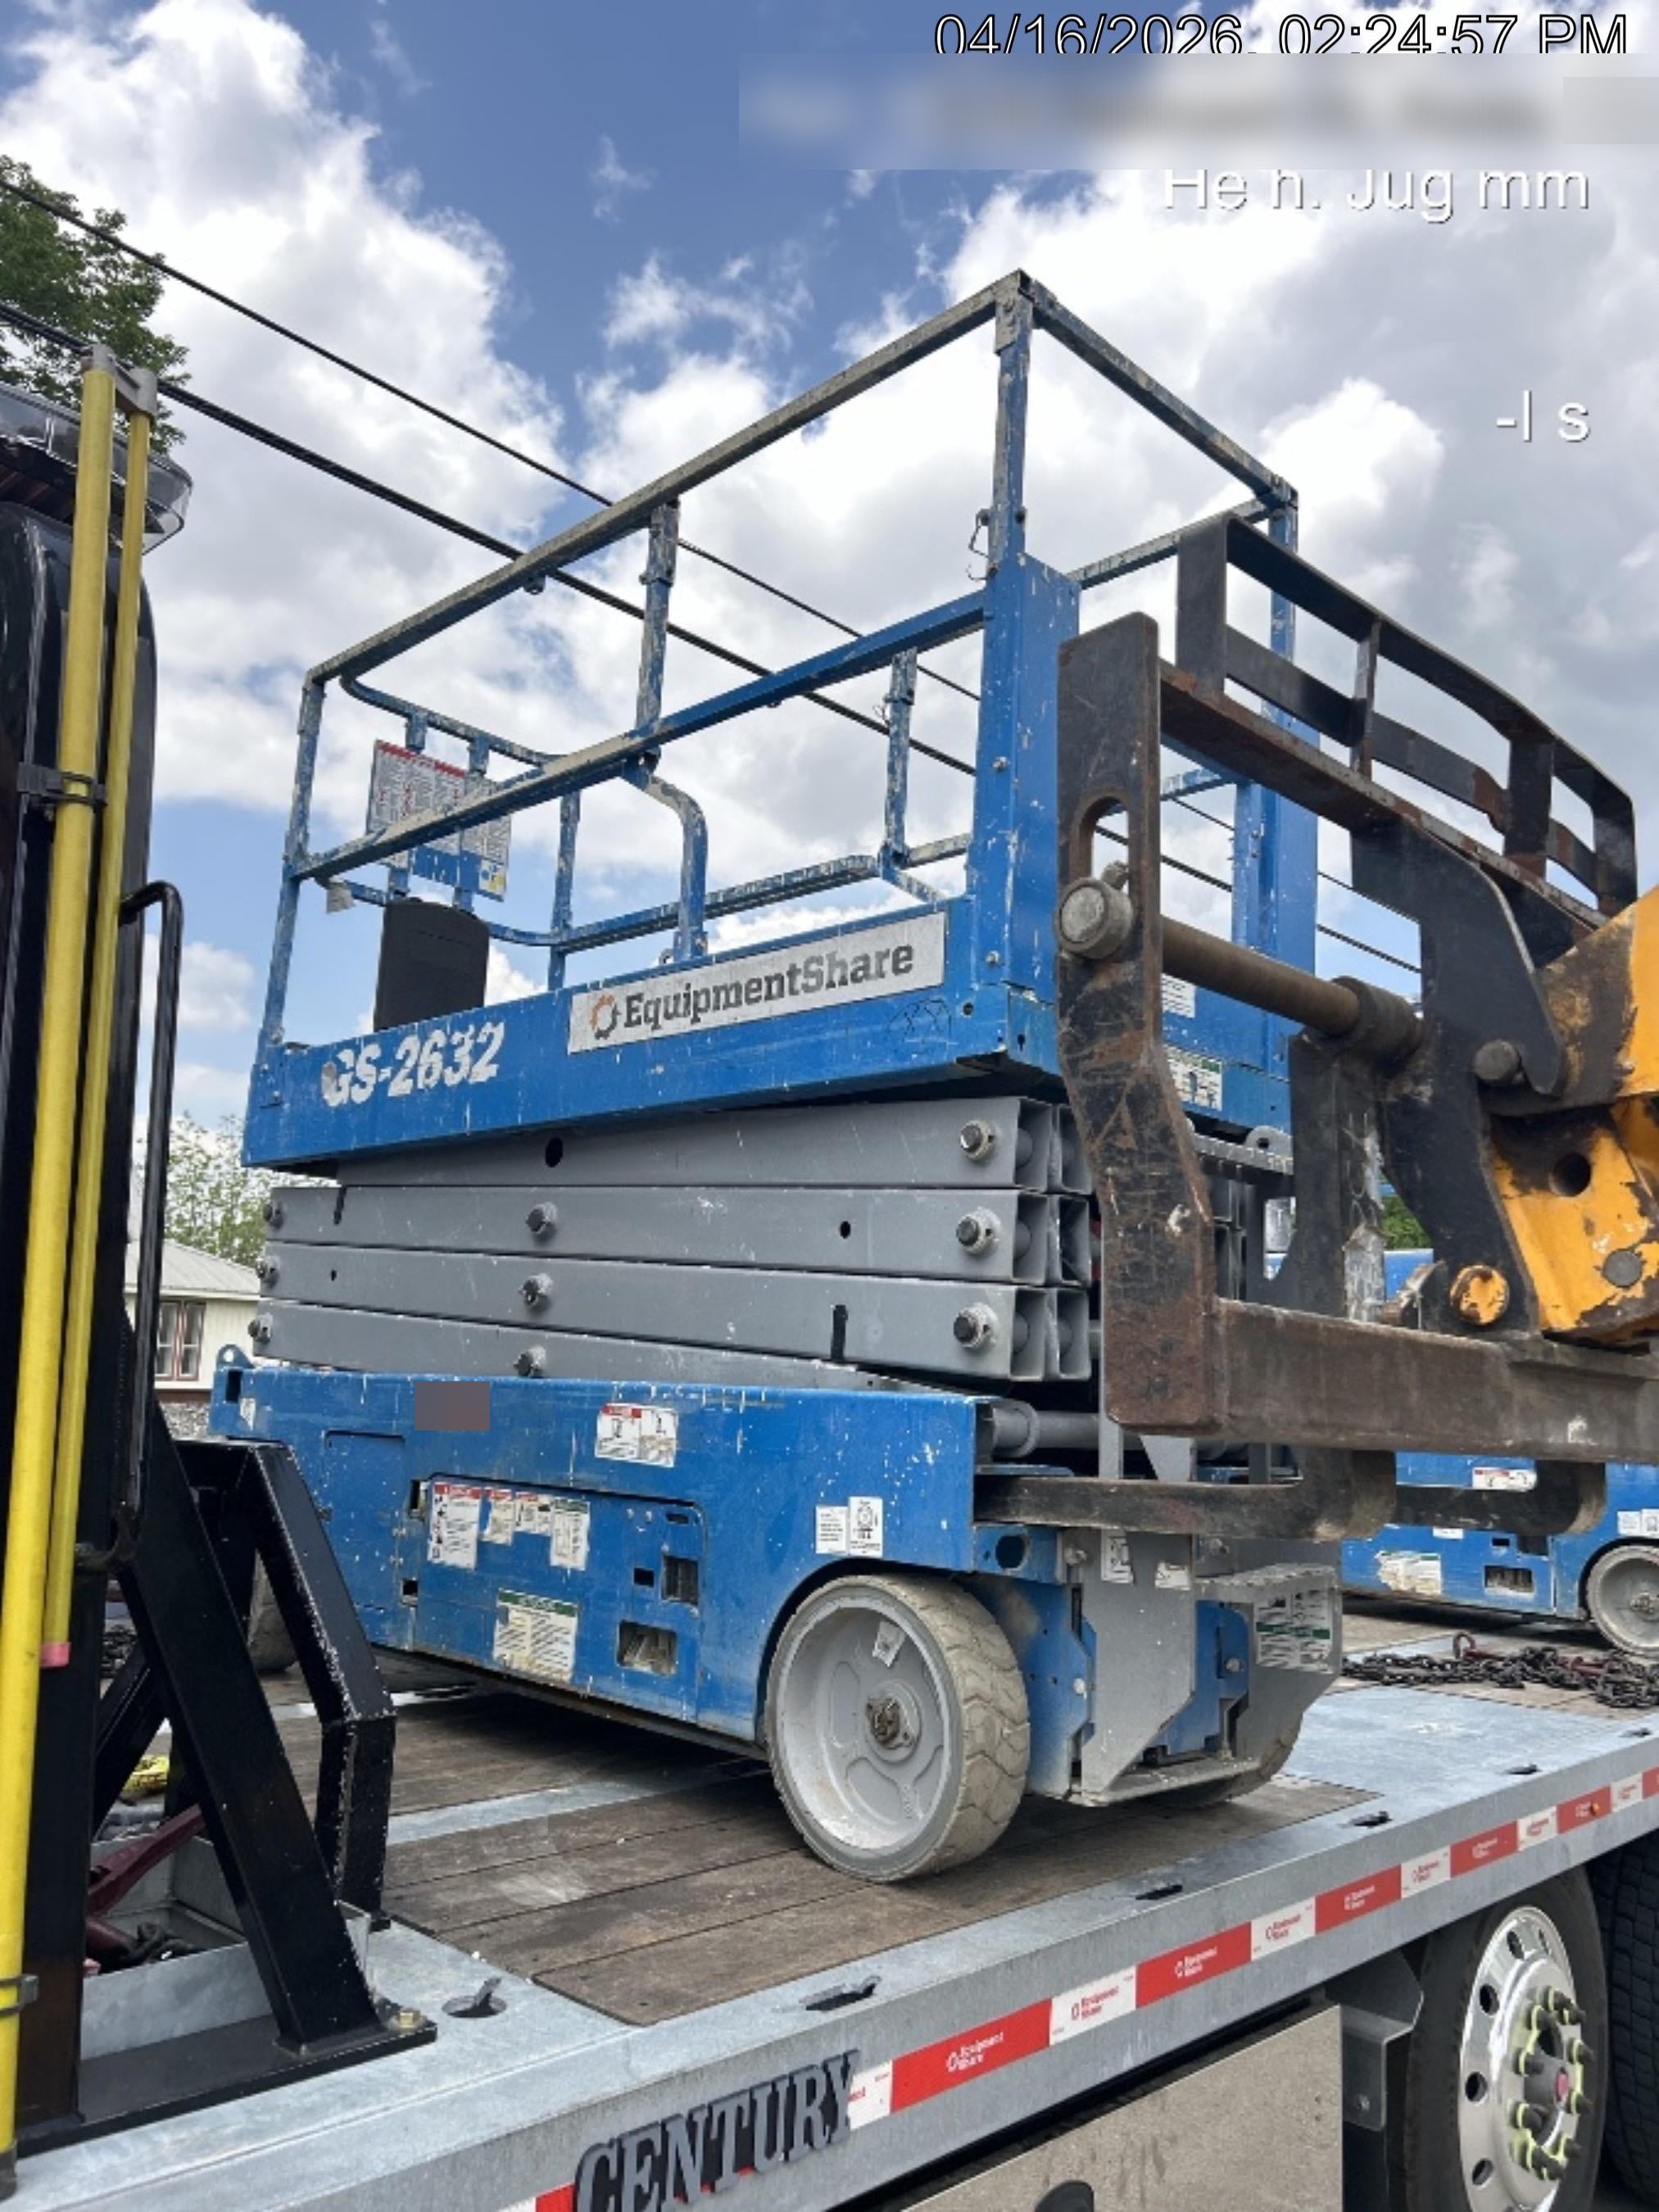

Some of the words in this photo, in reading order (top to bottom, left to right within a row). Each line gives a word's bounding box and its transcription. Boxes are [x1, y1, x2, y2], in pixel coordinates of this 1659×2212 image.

[623, 944, 913, 1031] EquipmentShare
[320, 1022, 505, 1107] GS-2632
[574, 2048, 860, 2212] CENTURY
